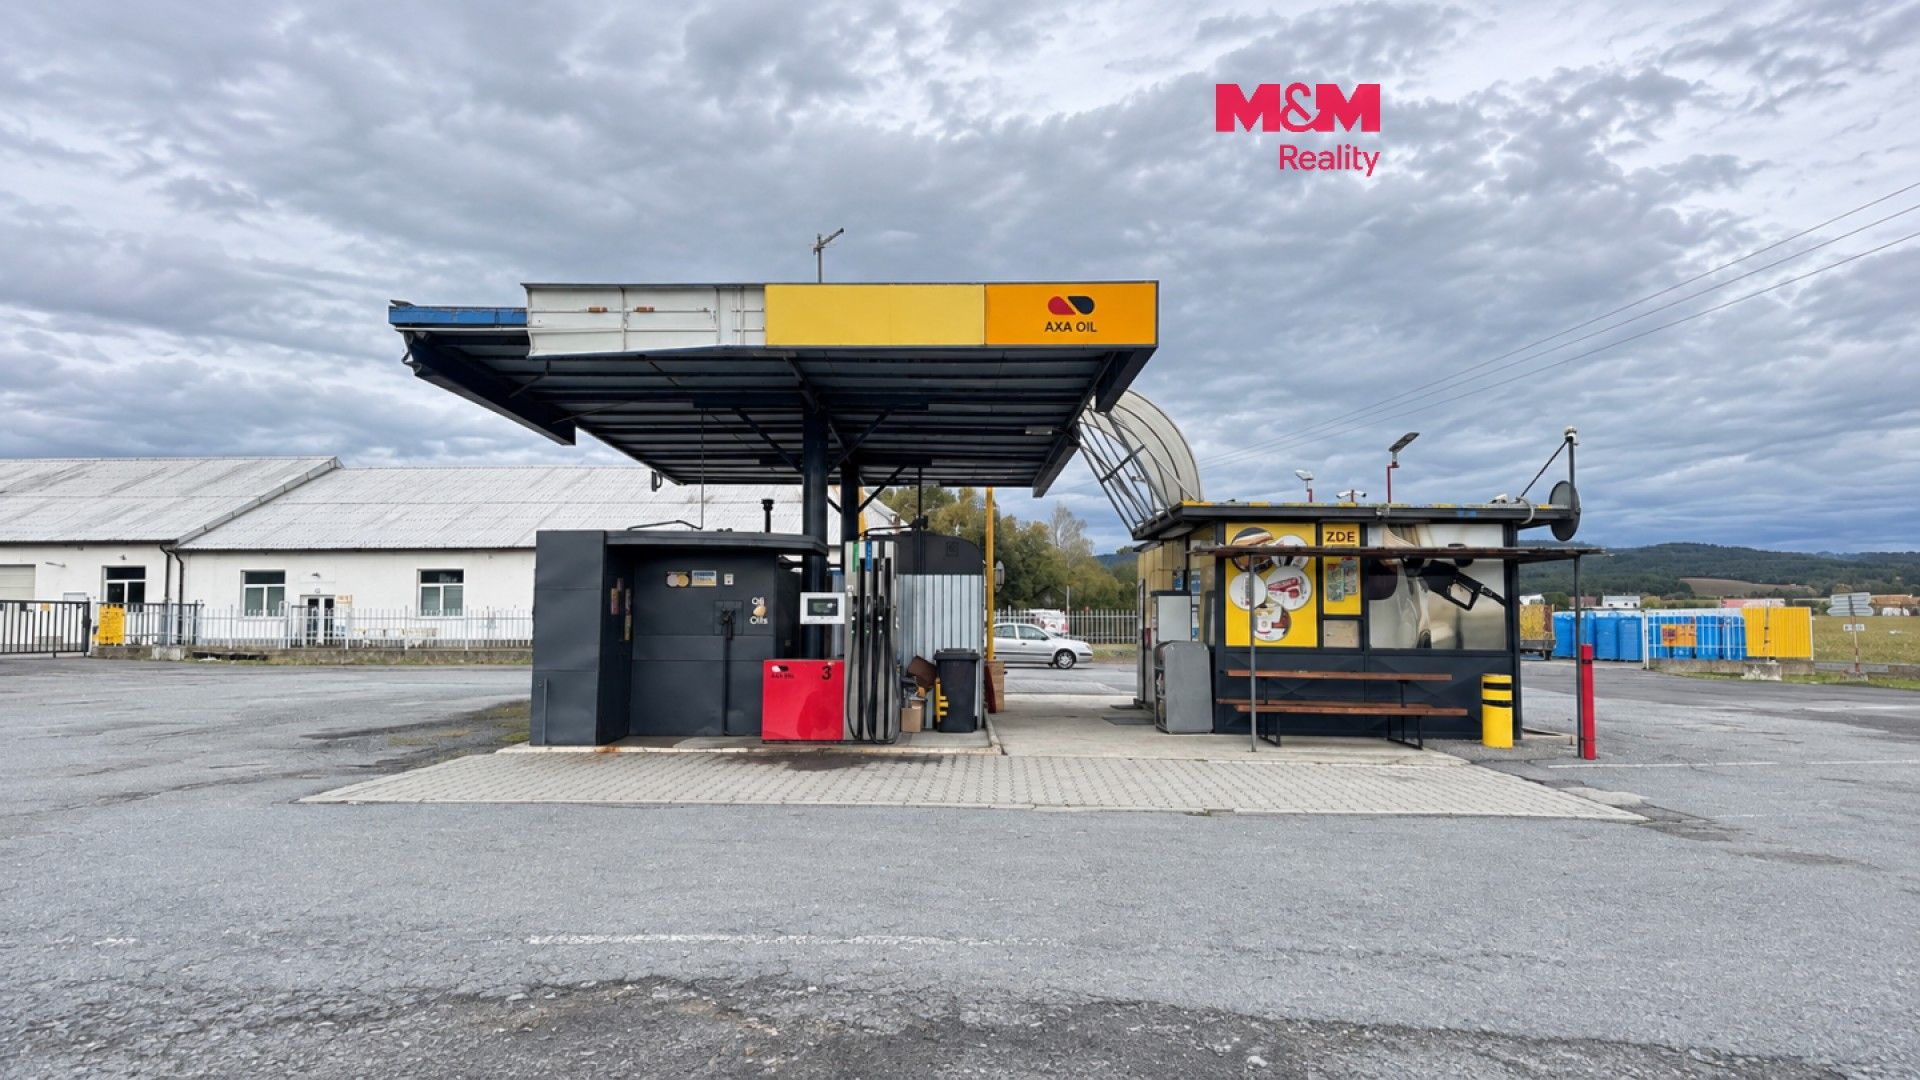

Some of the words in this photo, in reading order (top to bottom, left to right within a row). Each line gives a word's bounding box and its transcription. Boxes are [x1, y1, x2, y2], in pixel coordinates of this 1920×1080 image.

[1045, 321, 1072, 332] AXA
[1076, 321, 1097, 332] OIL
[1326, 531, 1355, 542] ZDE
[822, 666, 832, 680] 3
